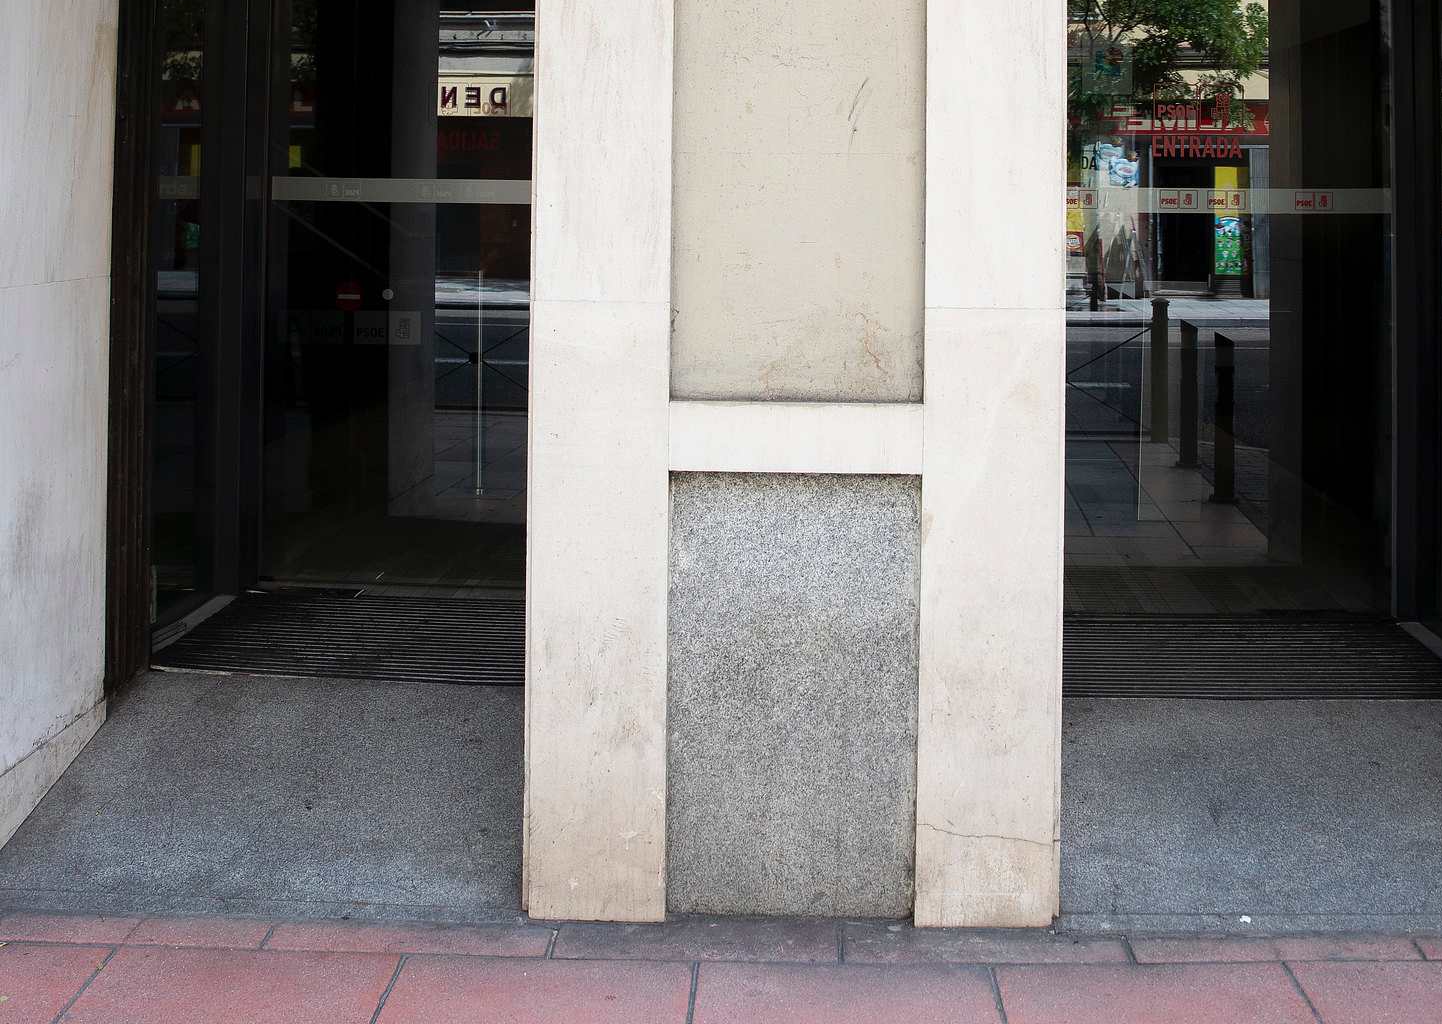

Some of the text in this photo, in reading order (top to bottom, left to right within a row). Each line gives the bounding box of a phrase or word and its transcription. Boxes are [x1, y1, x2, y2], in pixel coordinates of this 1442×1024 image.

[1152, 135, 1243, 159] ENTRADA
[1160, 197, 1178, 206] PSOE
[1208, 197, 1226, 206] PSOE
